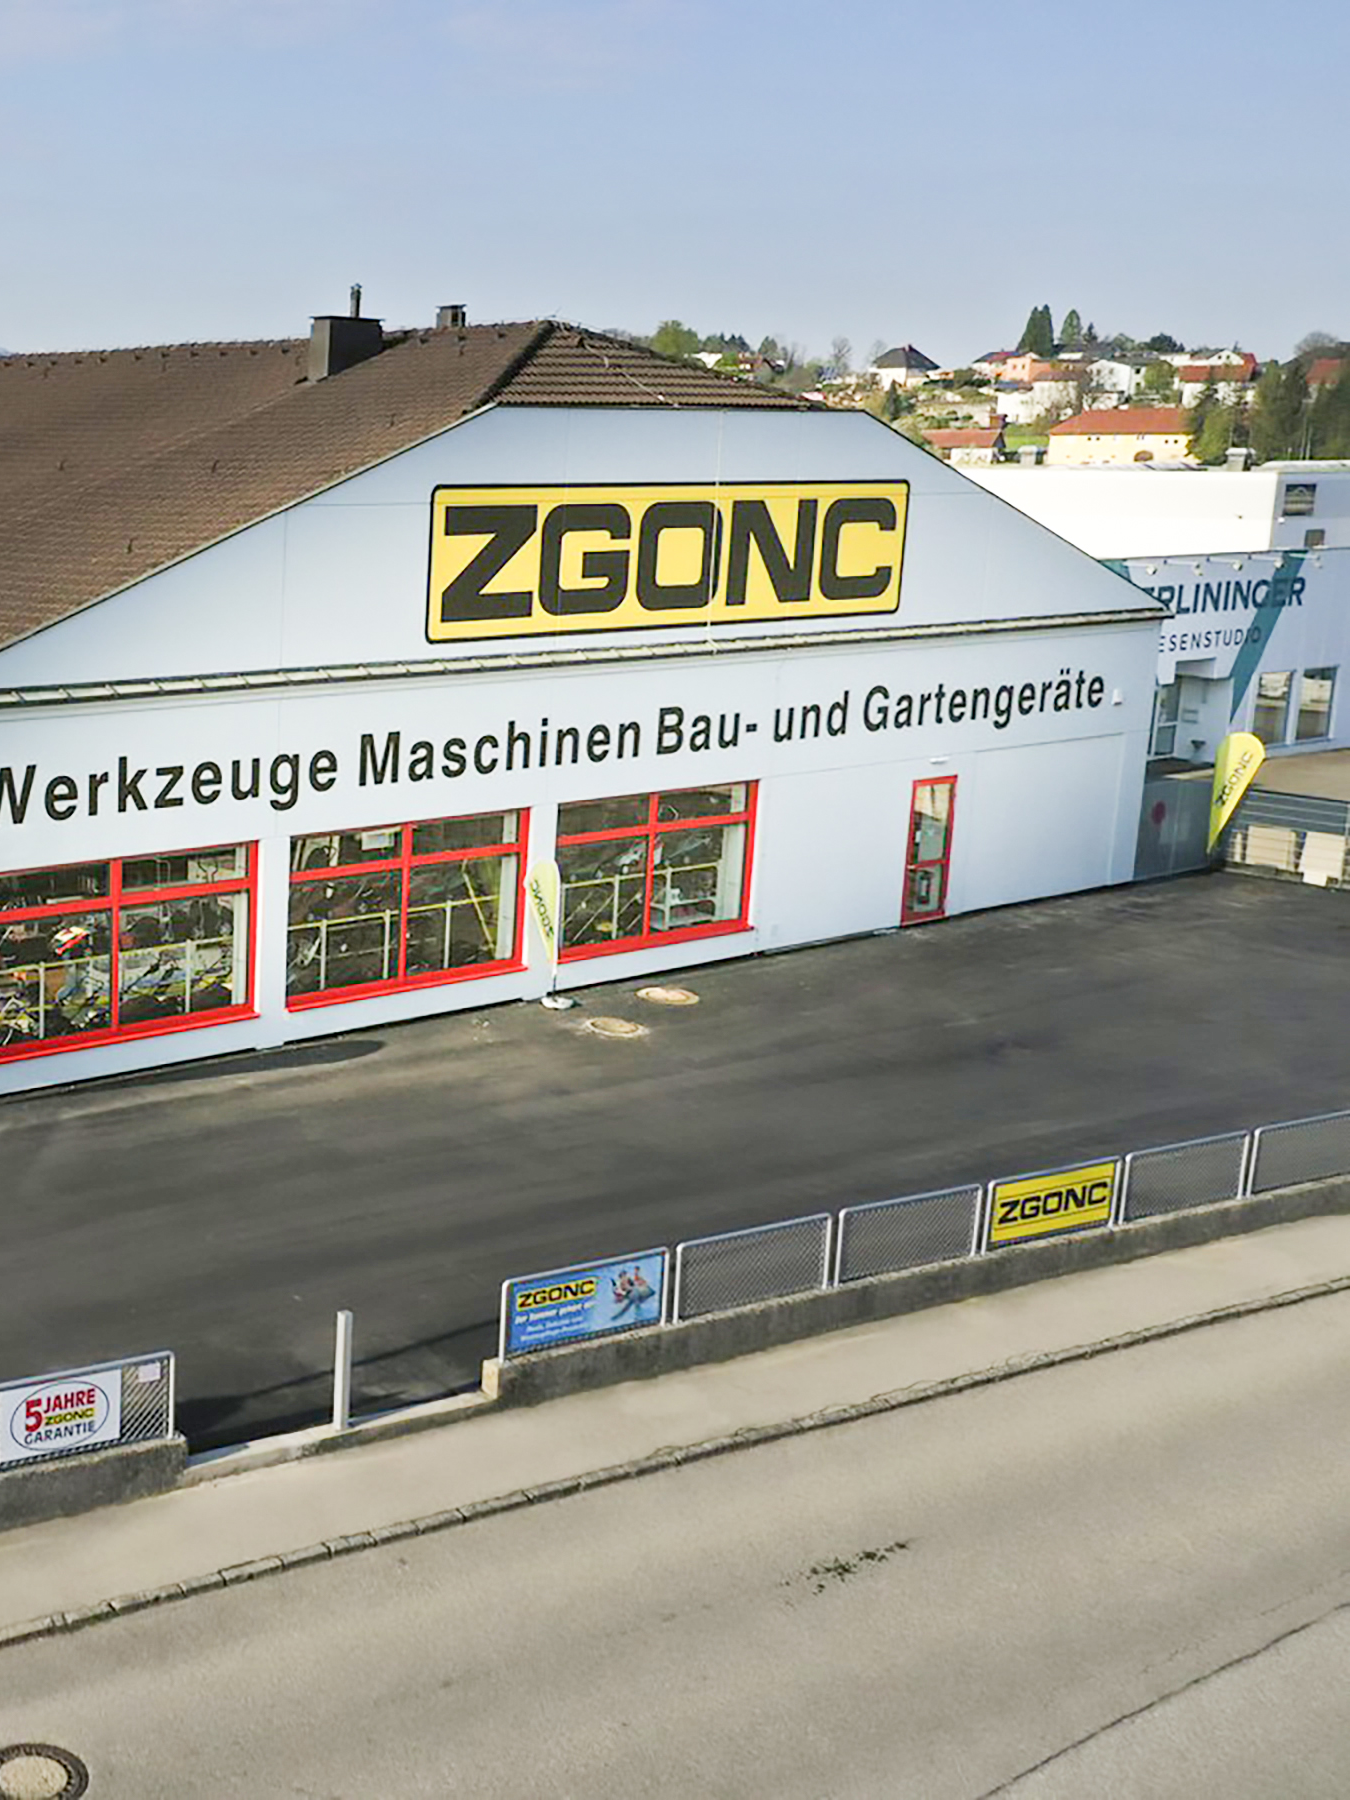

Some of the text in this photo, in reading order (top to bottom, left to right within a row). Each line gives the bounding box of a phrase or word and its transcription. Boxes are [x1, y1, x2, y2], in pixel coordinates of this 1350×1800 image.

[441, 497, 897, 623] ZGONC
[358, 718, 641, 787] Maschinen
[656, 706, 758, 755] Bau-
[773, 690, 850, 742] und
[862, 668, 1105, 732] Gartengeräte
[998, 1181, 1108, 1225] ZGONC
[518, 1280, 595, 1308] ZGONC
[25, 1388, 96, 1433] 5 JAHRE
[44, 1408, 95, 1426] ZGONC
[24, 1421, 96, 1445] GARANTIE
